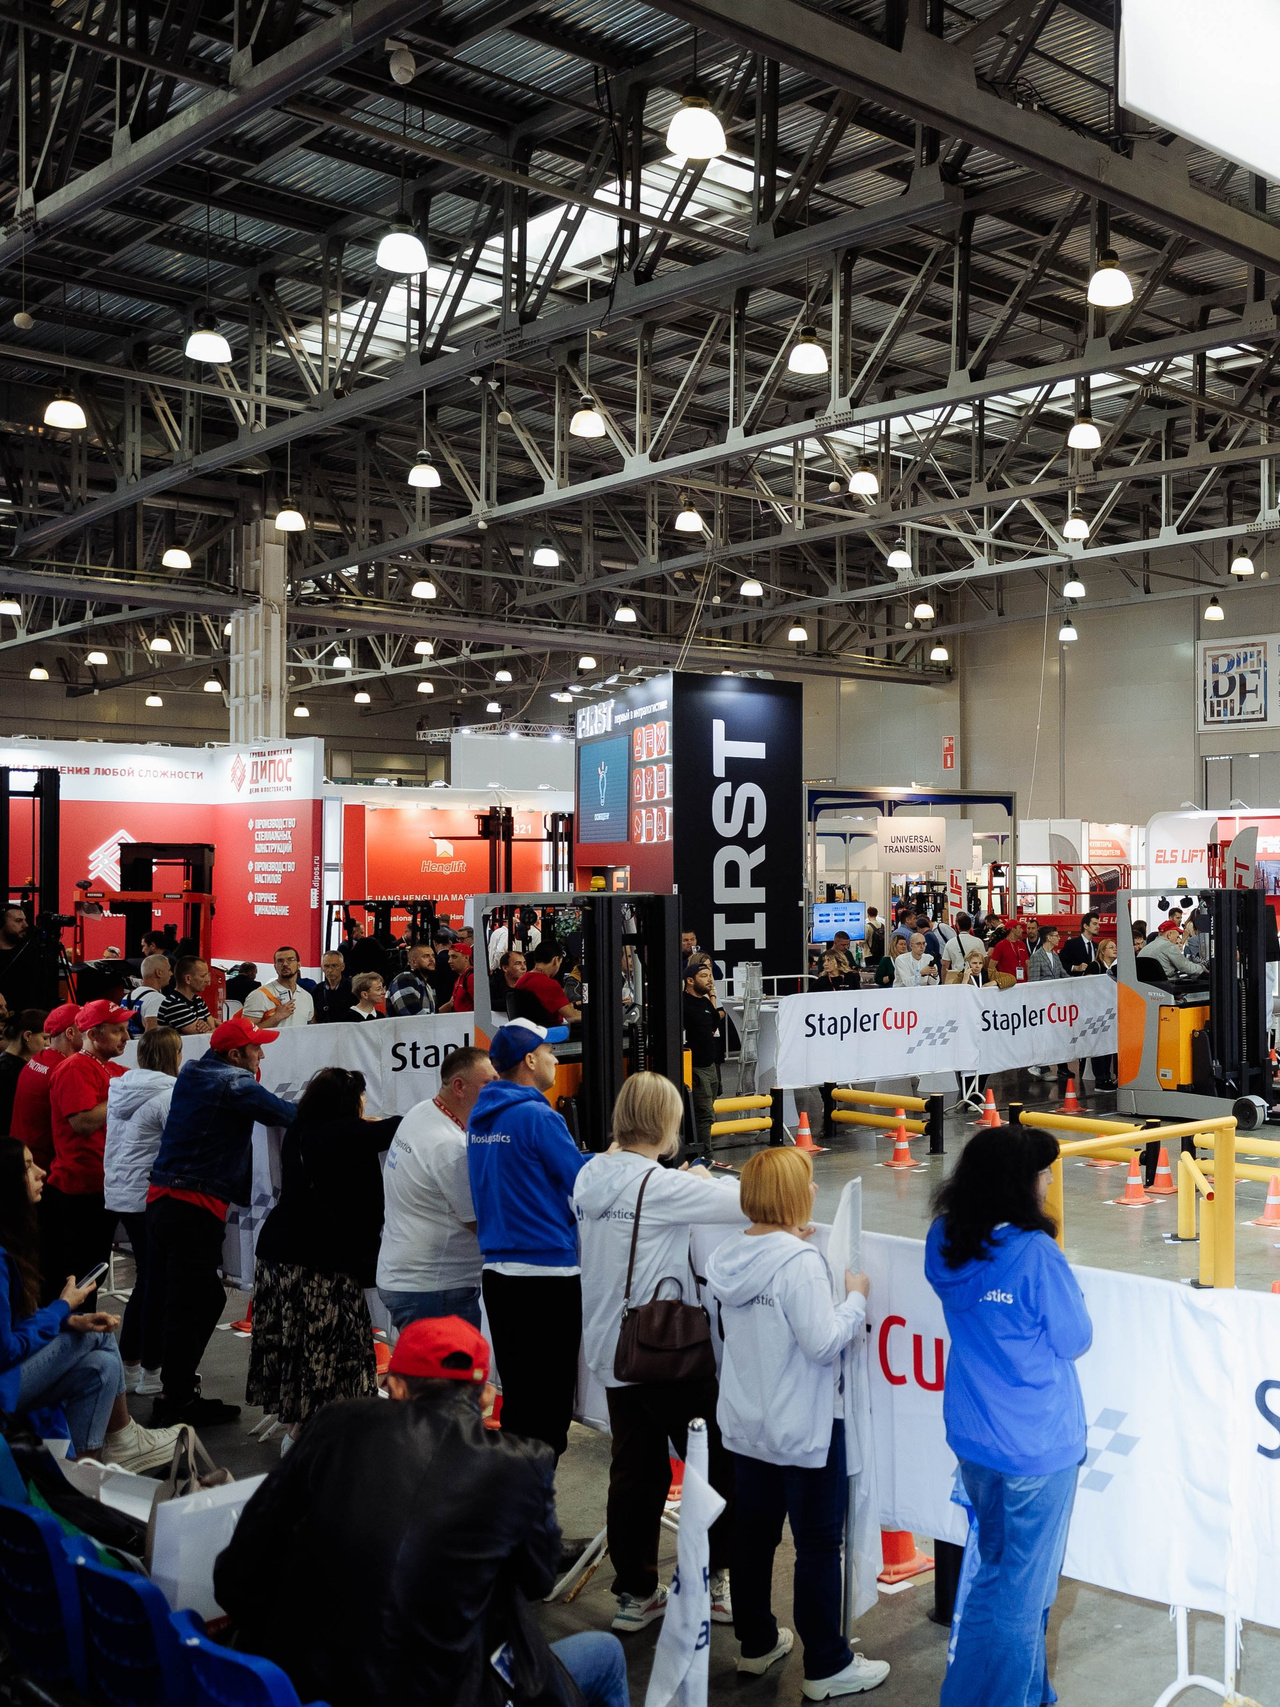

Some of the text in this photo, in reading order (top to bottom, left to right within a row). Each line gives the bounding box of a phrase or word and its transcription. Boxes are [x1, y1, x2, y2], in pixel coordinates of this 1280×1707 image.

[577, 698, 616, 739] FIRST
[33, 765, 90, 775] РЕНИЯ
[94, 767, 135, 777] ЛЮБОЙ
[138, 769, 204, 779] СЛОЖНОСТИ
[249, 758, 292, 784] ДИПОС
[255, 818, 296, 830] ПРОИЗВОДСТВО
[890, 835, 934, 844] UNIVERSAL
[884, 845, 941, 853] TRANSMISSION
[1155, 849, 1206, 863] ELS LIFT
[254, 862, 295, 873] ПРОИЗВОДСТВО
[421, 860, 467, 875] Henglift
[254, 874, 282, 884] НАСТИЛОВ
[804, 1007, 918, 1041] StaplerCup
[981, 1002, 1079, 1035] StaplerCup
